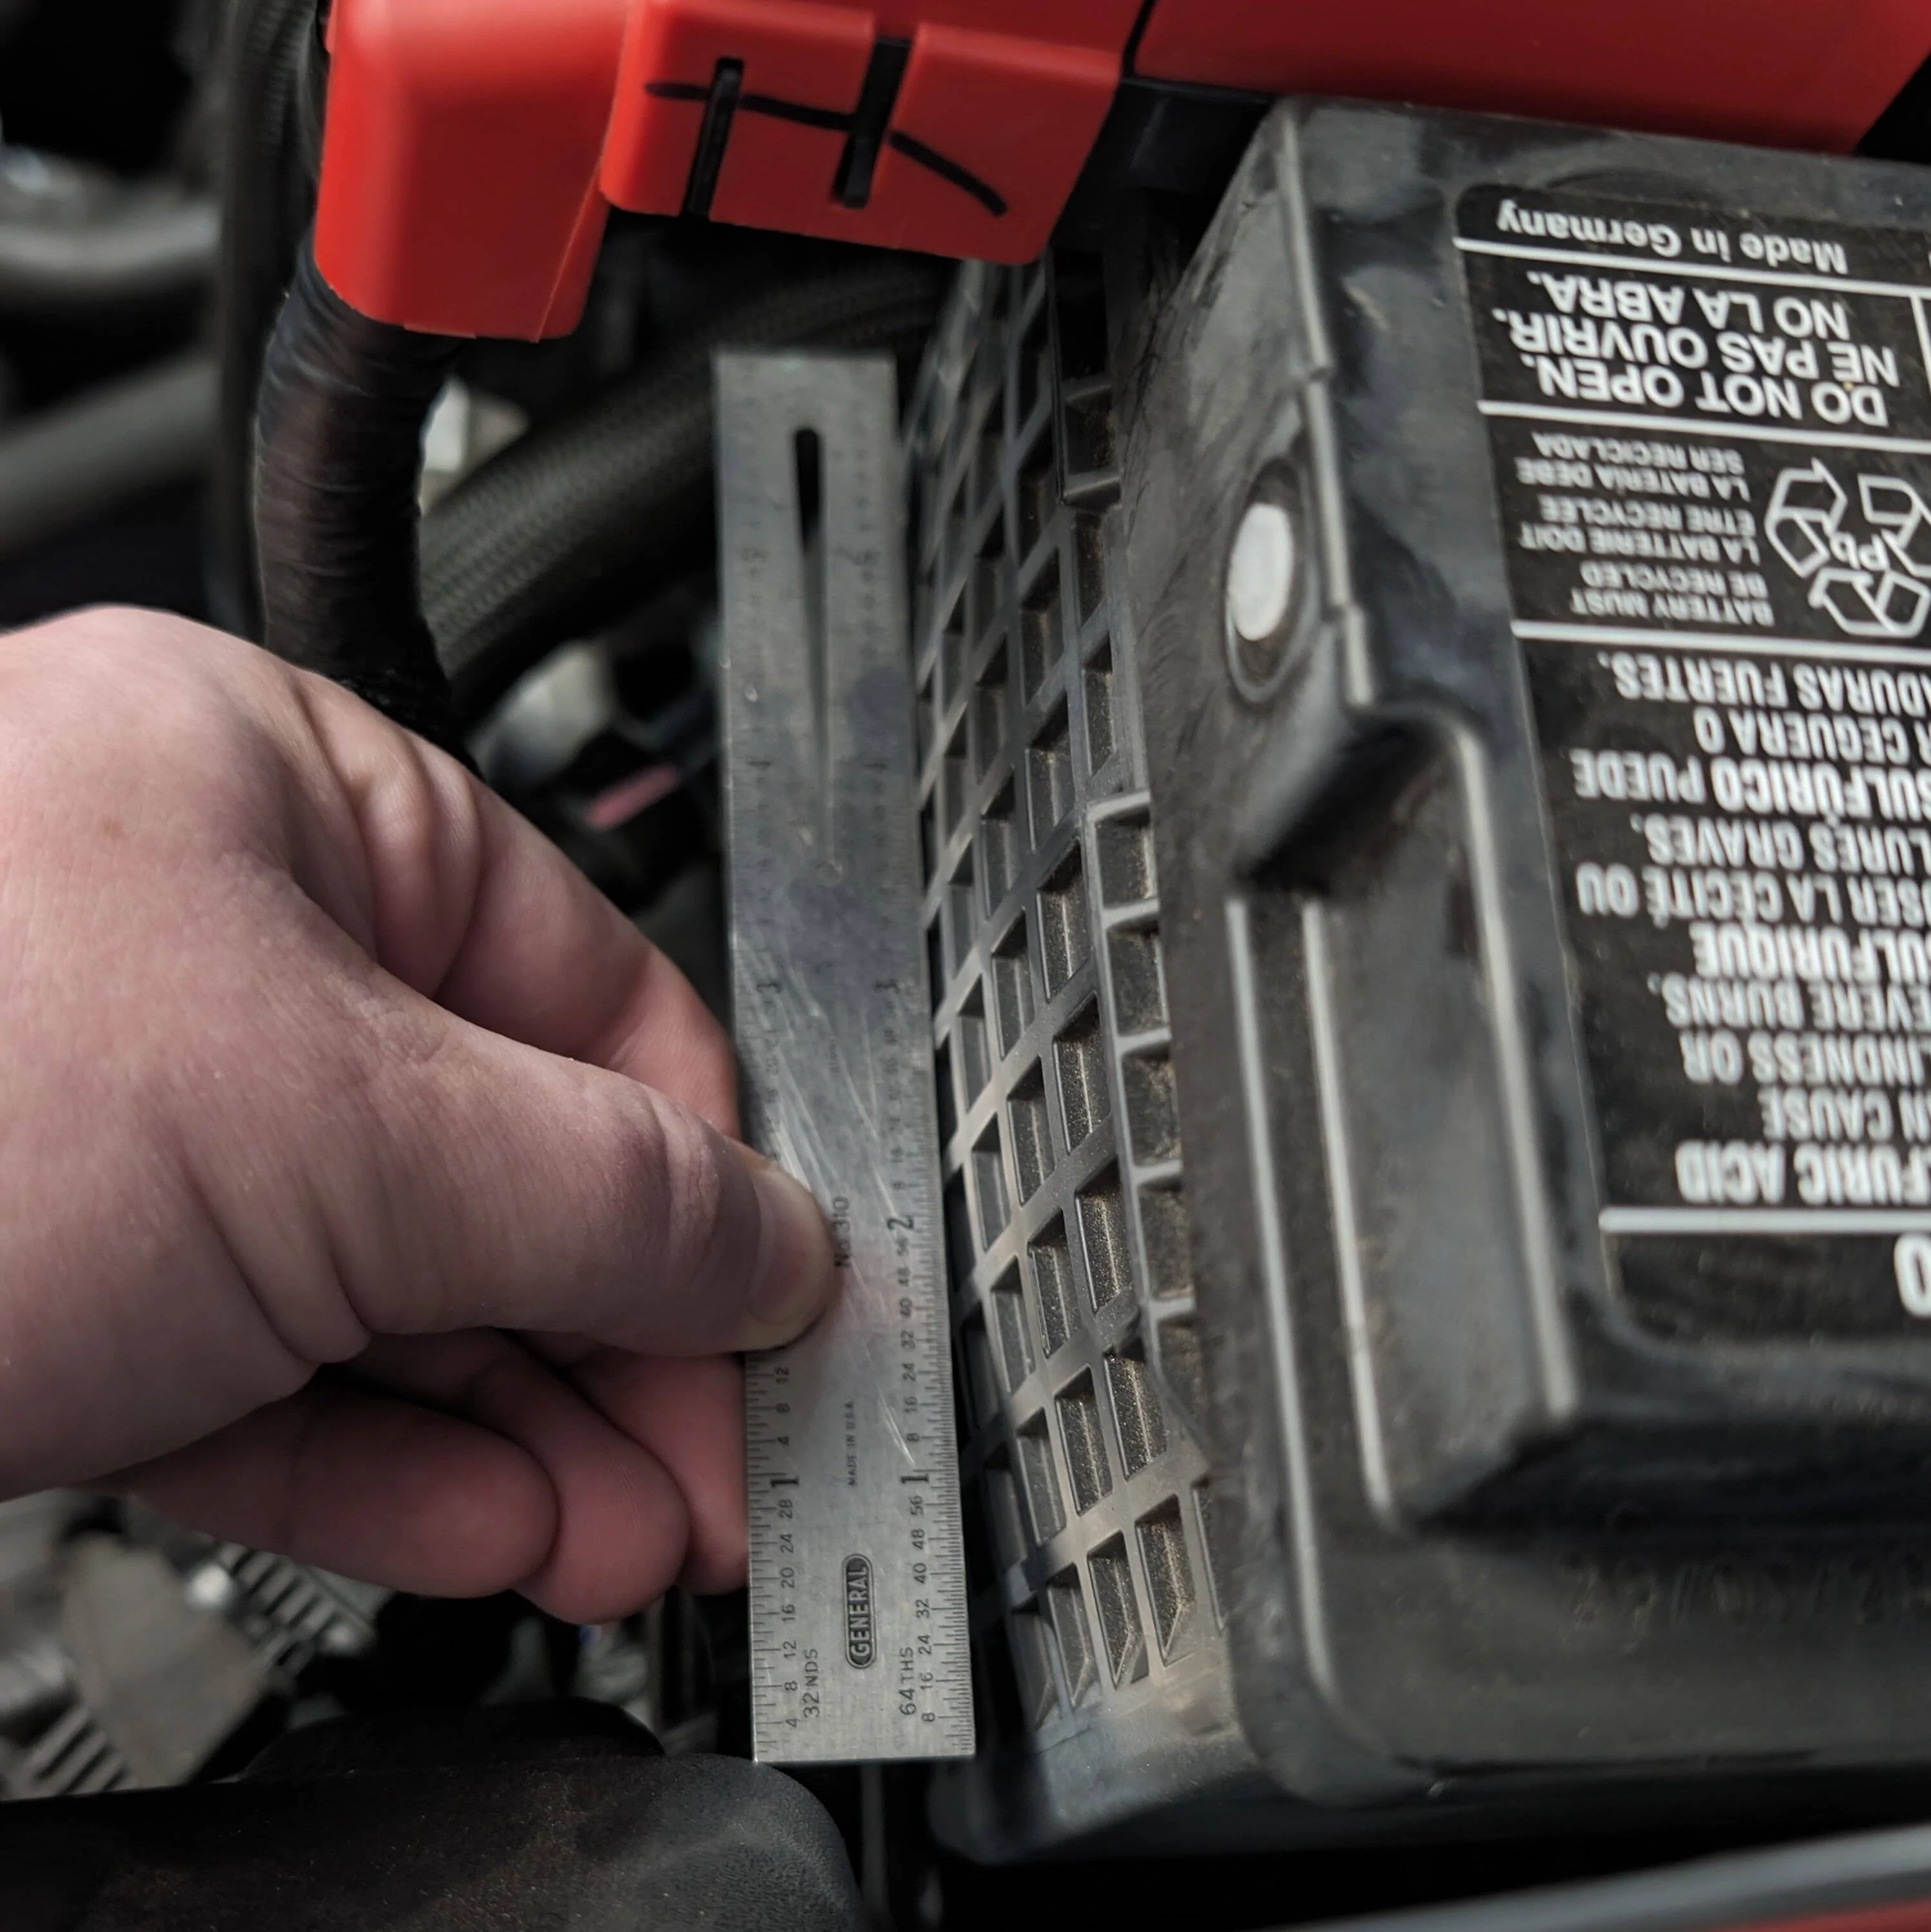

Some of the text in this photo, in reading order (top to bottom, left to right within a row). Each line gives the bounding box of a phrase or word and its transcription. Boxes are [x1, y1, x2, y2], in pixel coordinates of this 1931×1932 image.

[1496, 198, 1848, 275] Made in Germany
[1527, 270, 1850, 341] NO LA ABRA.
[1491, 307, 1900, 387] NE PAS OUVRIR.
[1521, 353, 1889, 428] DO NOT OPEN.
[1531, 431, 1746, 475] SER RECICLADA
[1513, 457, 1594, 489] DEBE
[1710, 475, 1751, 503] LA
[1518, 521, 1761, 567] LA BATTERIE DOIT
[1829, 532, 1890, 572] Pb
[1579, 560, 1769, 600] BE RECYCLED
[1570, 588, 1775, 628] BATTERY MUST
[1597, 650, 1788, 708] FUERTES.
[1693, 706, 1726, 754] O
[1729, 709, 1910, 765] CEGUERA
[1569, 748, 1706, 804] PUEDE
[1630, 813, 1804, 871] GRAVES.
[1576, 862, 1639, 918] OU
[1785, 873, 1842, 924] LA
[1690, 922, 1931, 983] ULFURIQUE
[1647, 971, 1804, 1030] BURNS.
[1679, 1030, 1744, 1085] OR
[1758, 1087, 1894, 1141] CAUSE
[1675, 1139, 1931, 1206] FURIC ACID
[887, 1215, 914, 1231] 2
[775, 1366, 790, 1383] 12
[903, 1362, 917, 1383] 24
[904, 1396, 918, 1414] 16
[777, 1435, 790, 1446] 4
[907, 1432, 921, 1444] 8
[771, 1475, 800, 1488] 1
[847, 1454, 858, 1487] MADE
[901, 1473, 929, 1484] 1
[779, 1498, 793, 1519] 28
[910, 1495, 924, 1517] 56
[780, 1533, 795, 1553] 24
[912, 1528, 925, 1549] 48
[781, 1567, 795, 1589] 20
[913, 1562, 927, 1584] 40
[782, 1604, 796, 1622] 16
[848, 1566, 872, 1657] GENERAL
[915, 1598, 929, 1618] 32
[784, 1640, 797, 1660] 12
[918, 1634, 931, 1656] 24
[784, 1680, 798, 1692] 8
[919, 1671, 934, 1690] 16
[785, 1718, 798, 1728] 4
[921, 1712, 936, 1723] 8
